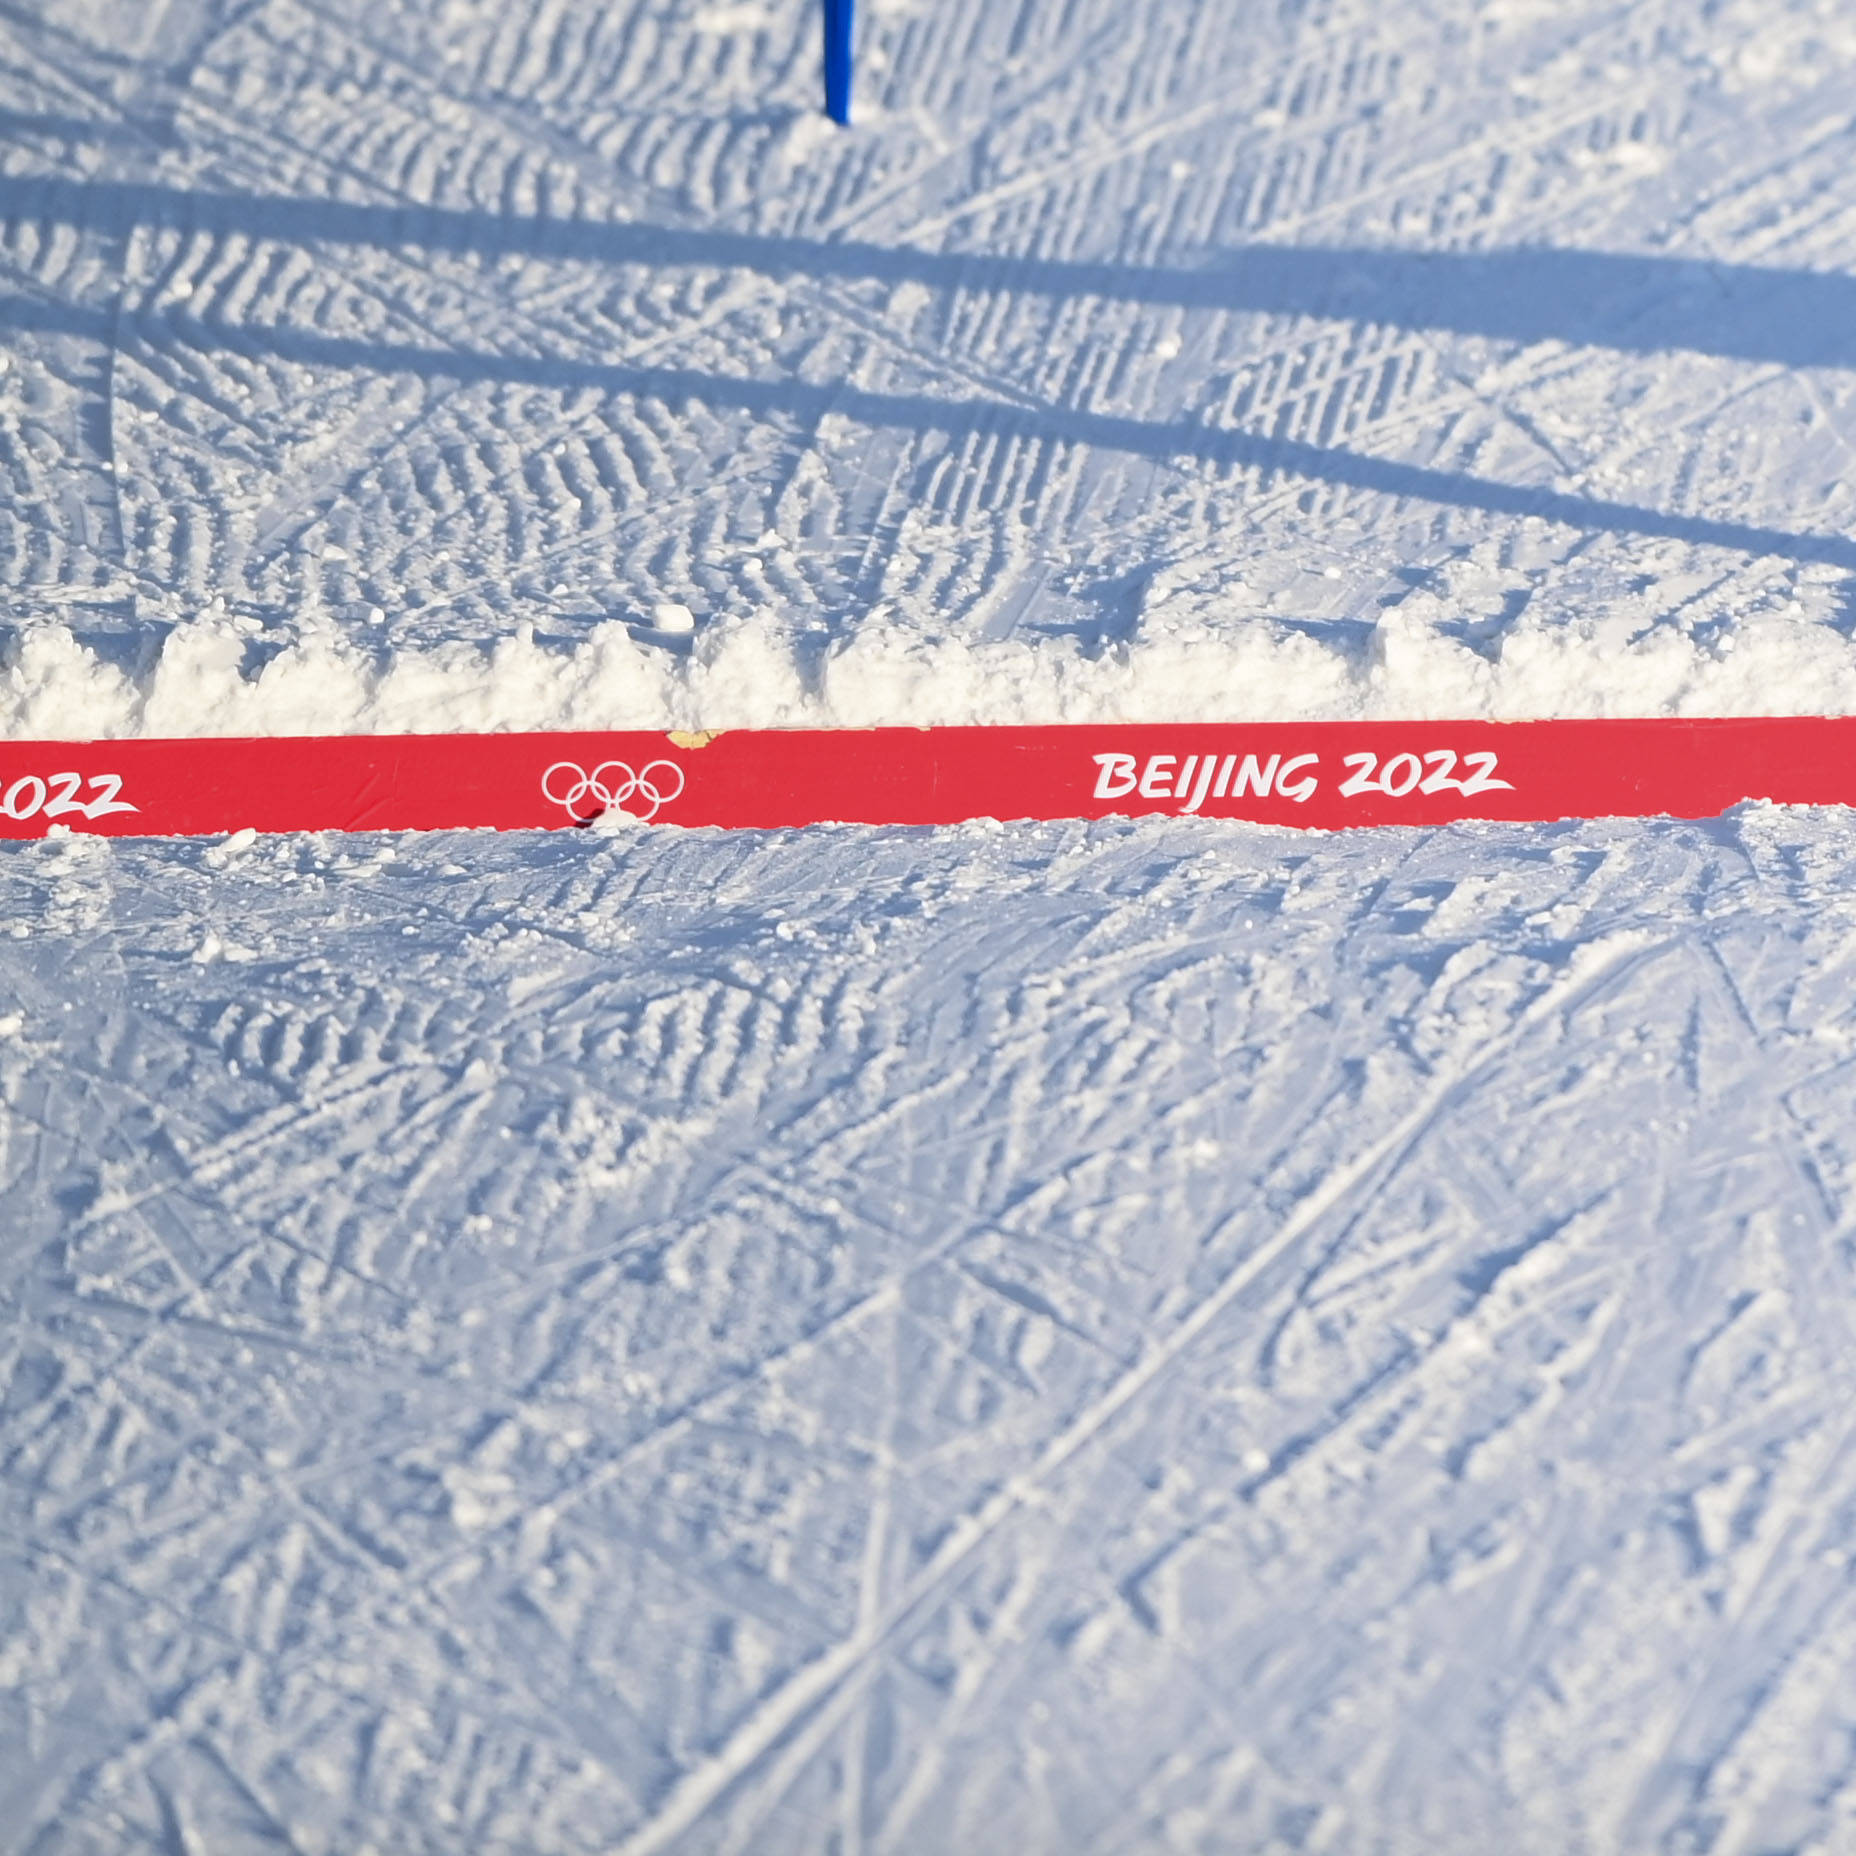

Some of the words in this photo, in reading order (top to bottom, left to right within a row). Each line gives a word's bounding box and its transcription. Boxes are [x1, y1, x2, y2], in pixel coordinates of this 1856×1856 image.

[0, 772, 142, 820] 022
[1092, 752, 1317, 814] BEIJING
[1339, 749, 1518, 798] 2022
